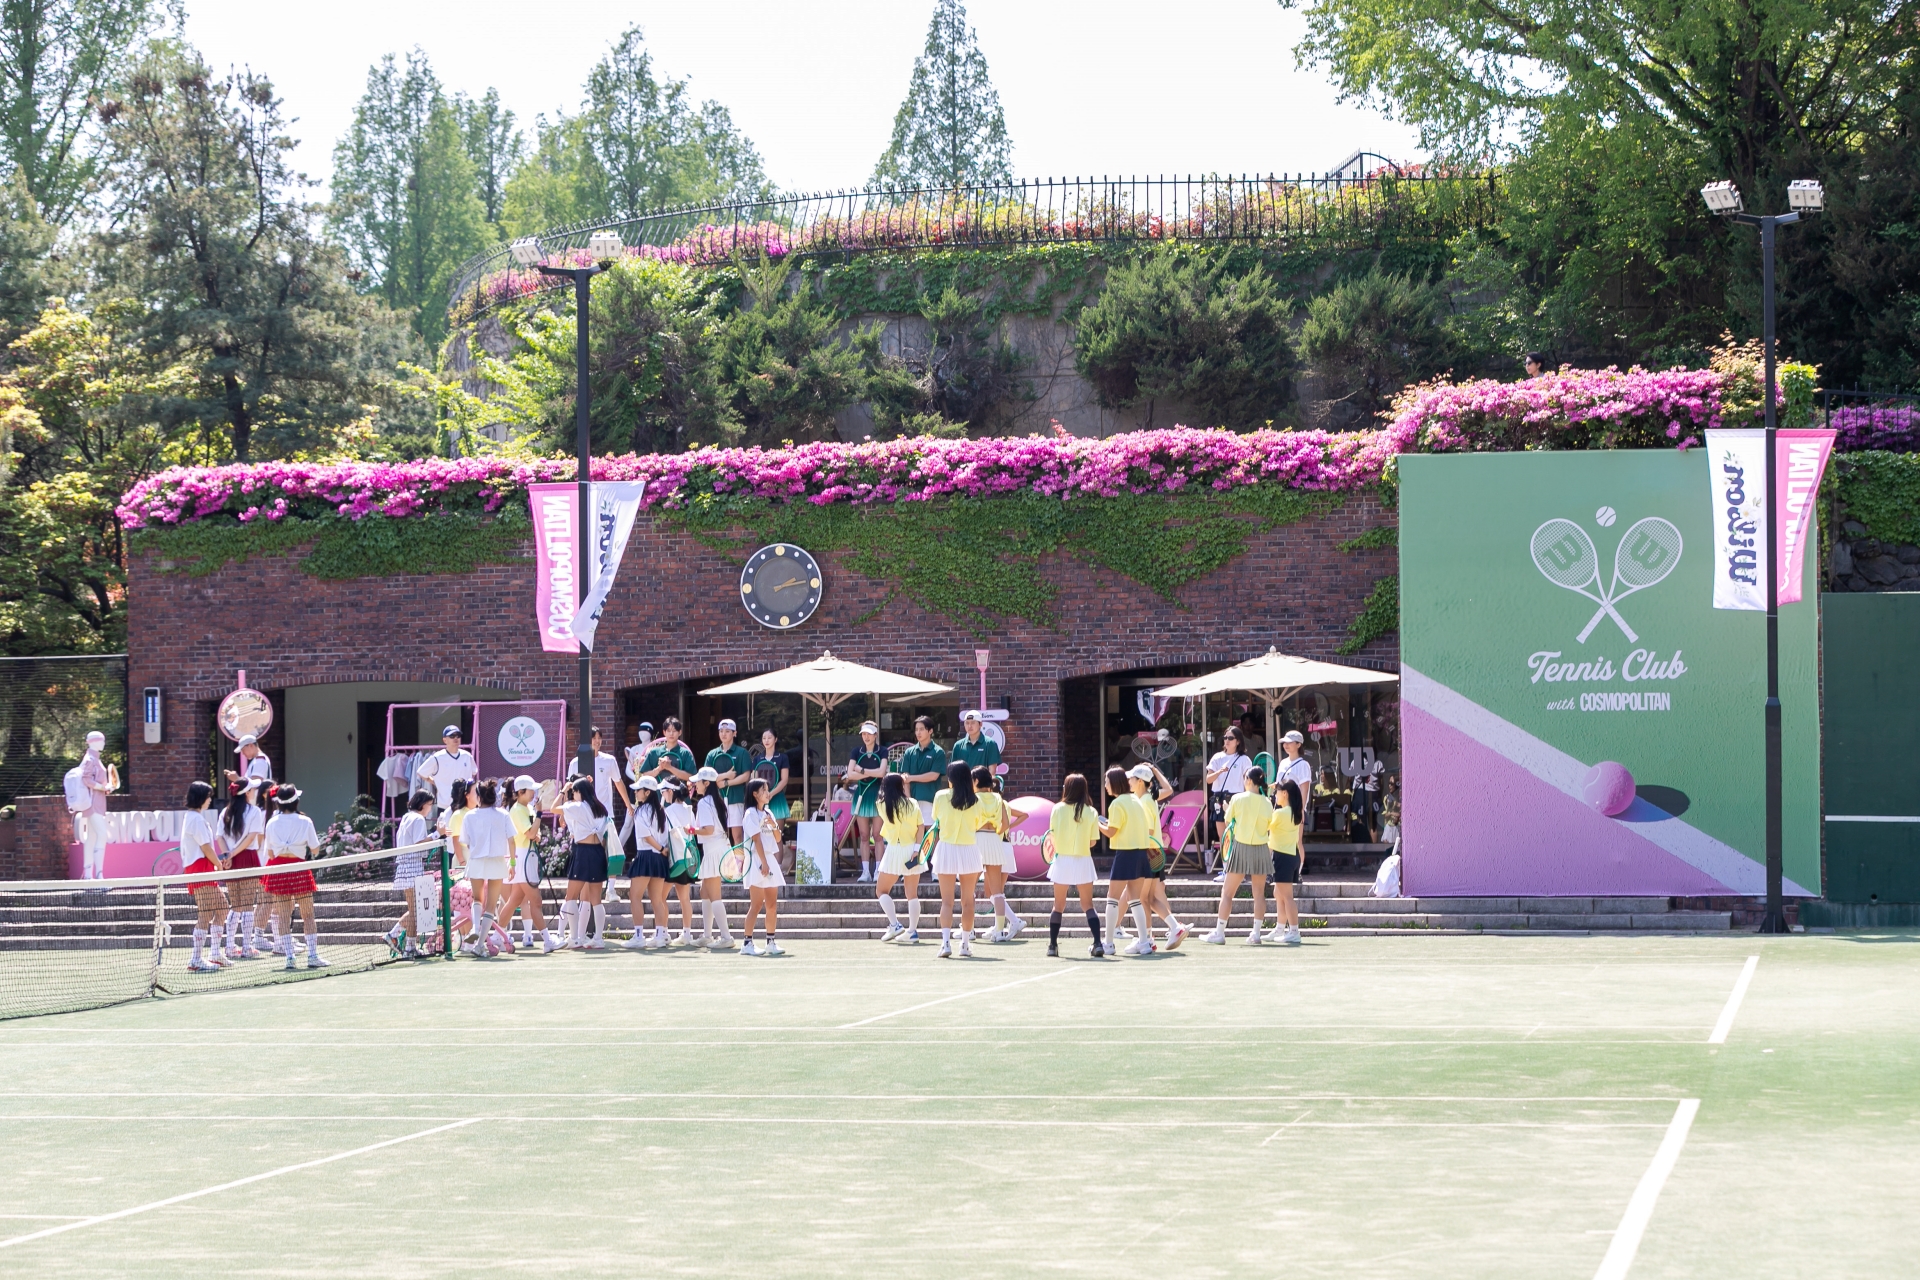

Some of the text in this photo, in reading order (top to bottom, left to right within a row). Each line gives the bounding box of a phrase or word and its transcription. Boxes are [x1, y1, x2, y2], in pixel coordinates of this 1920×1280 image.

[1527, 648, 1688, 684] Tennis Club
[1547, 692, 1671, 712] with COSMOPOLITAN
[820, 765, 848, 776] COSMOP
[74, 809, 219, 844] CSMOPOL
[1010, 829, 1044, 847] ilso
